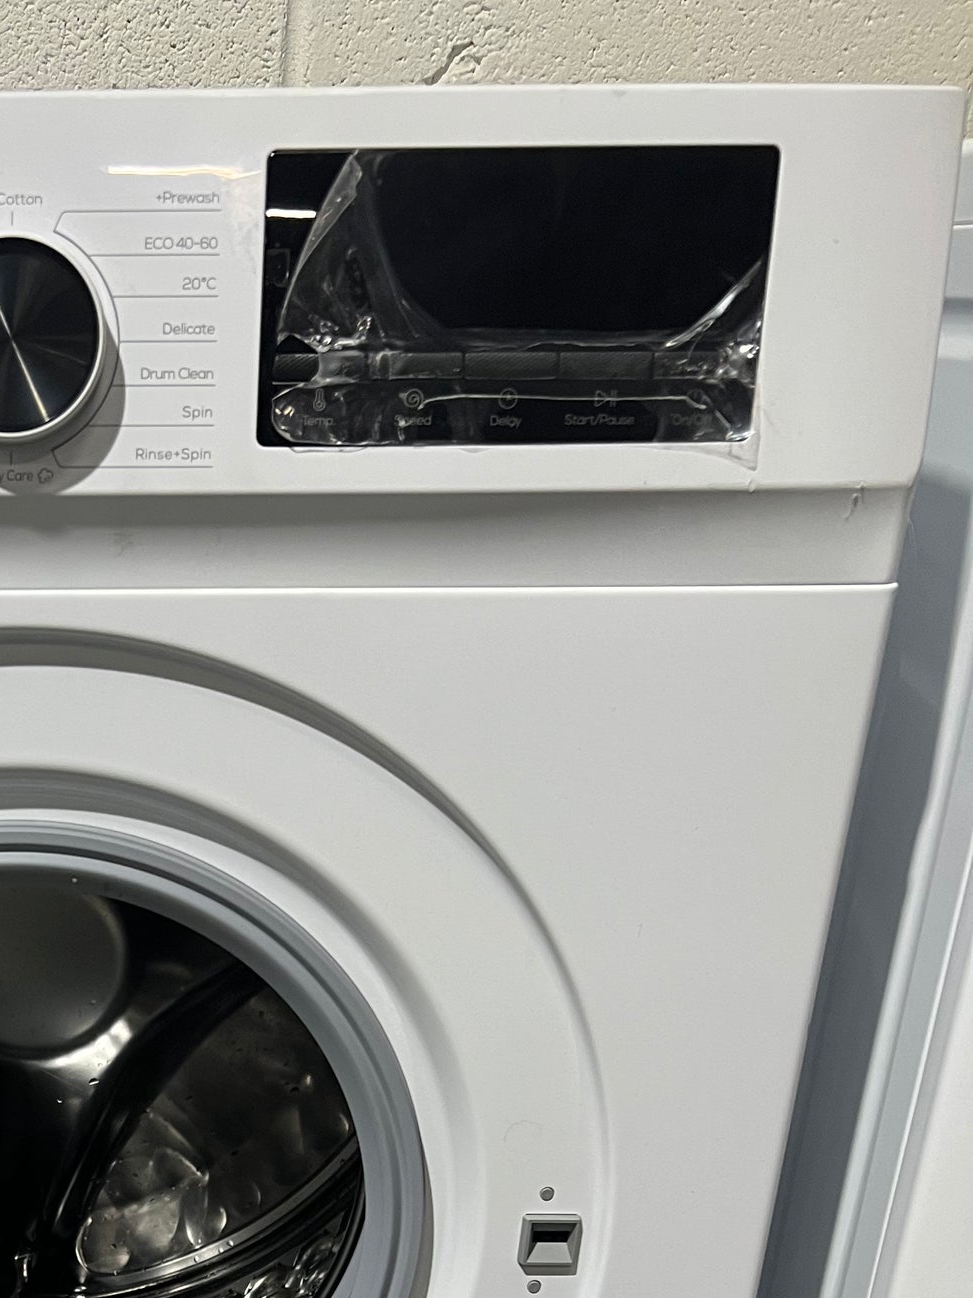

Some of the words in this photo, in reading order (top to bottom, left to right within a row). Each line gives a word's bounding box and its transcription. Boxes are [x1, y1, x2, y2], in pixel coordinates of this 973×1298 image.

[156, 191, 220, 205] +Prewash
[144, 237, 174, 250] ECO
[176, 237, 219, 250] 40-60
[182, 276, 218, 290] 20°C
[162, 322, 216, 336] Delicate
[140, 367, 176, 381] Drum
[178, 367, 214, 381] Clean
[181, 405, 213, 421] Spin
[564, 413, 635, 426] Start/Pause
[489, 414, 522, 429] Delay
[135, 448, 212, 464] Rinse+Spin
[7, 469, 34, 481] Care
